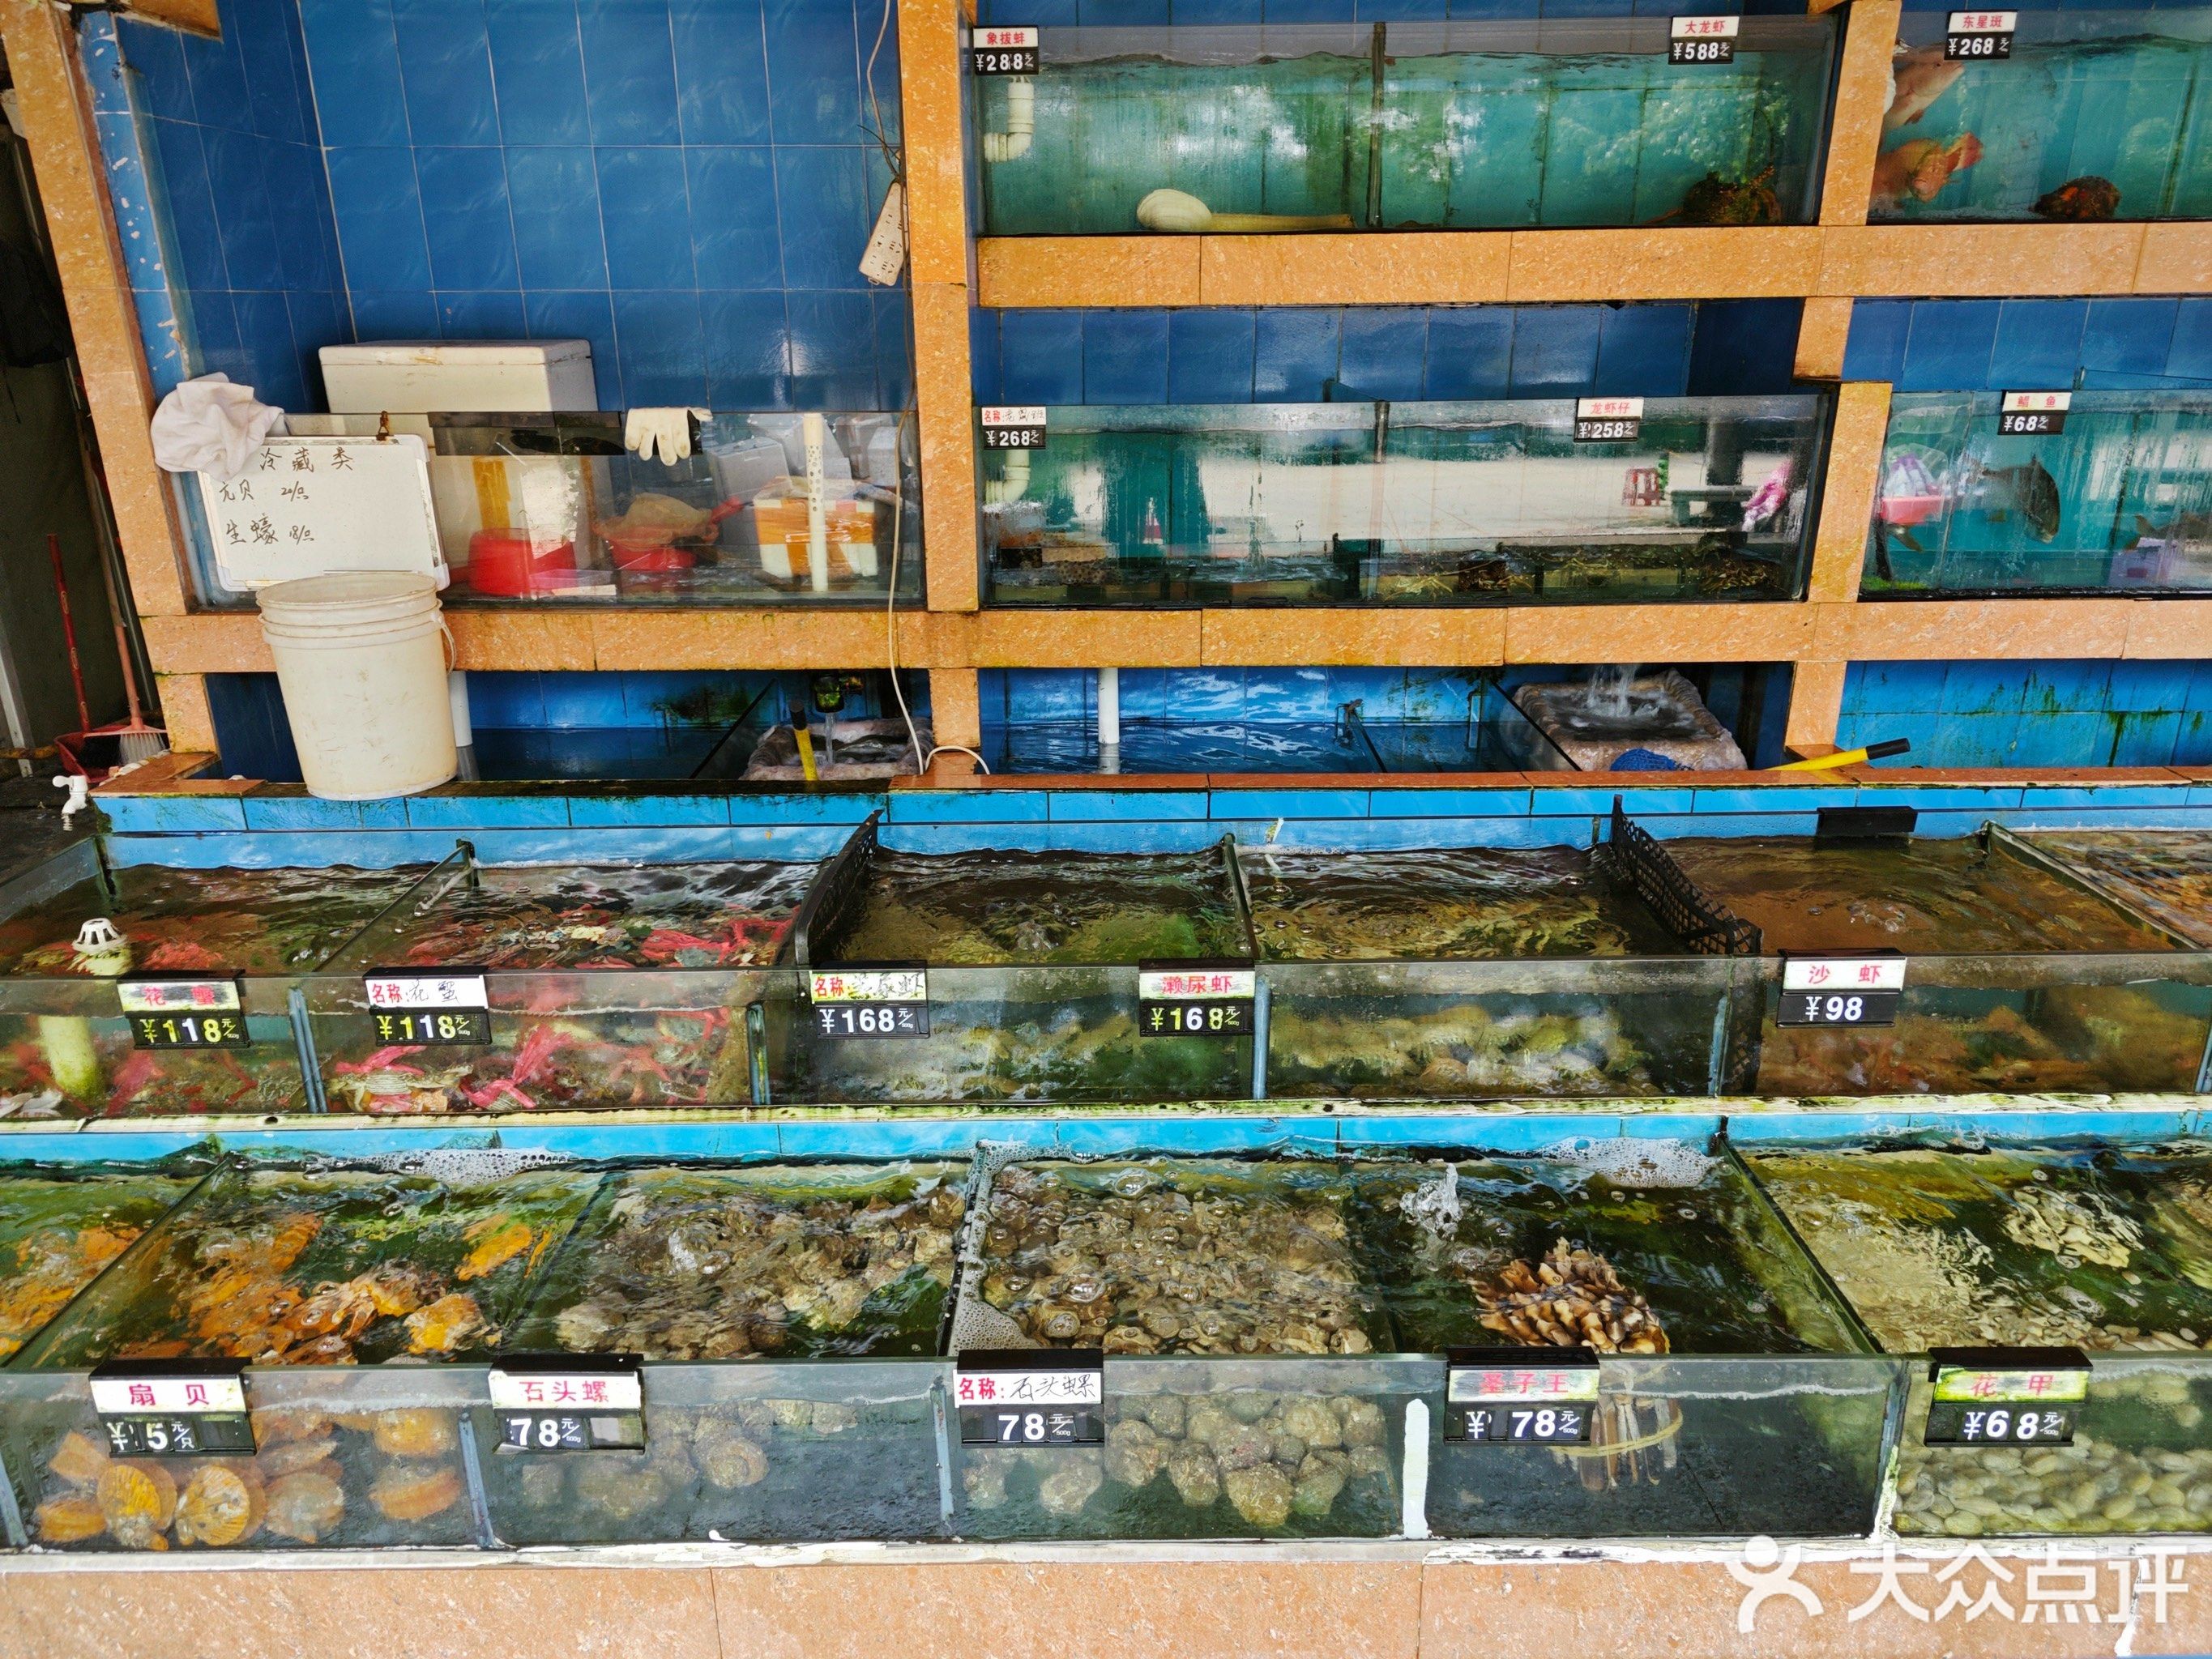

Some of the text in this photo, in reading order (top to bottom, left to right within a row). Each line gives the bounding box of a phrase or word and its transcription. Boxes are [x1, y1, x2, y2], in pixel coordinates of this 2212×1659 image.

[1685, 20, 1726, 34] 大龙虾
[1962, 15, 2003, 29] 东星斑
[986, 32, 1025, 45] 象拔蚌
[1591, 402, 1630, 415] 龙虾仔
[259, 447, 353, 472] 冷藏类
[1161, 975, 1232, 995] 濑尿虾
[1808, 964, 1882, 984] 沙虾
[1151, 1007, 1223, 1031] ¥168
[1804, 996, 1863, 1021] ¥98
[819, 1009, 895, 1033] ¥168
[129, 1384, 210, 1406] 扇贝
[519, 1380, 609, 1402] 石头螺
[1971, 1374, 2054, 1397] 花甲
[998, 1414, 1045, 1440] 78
